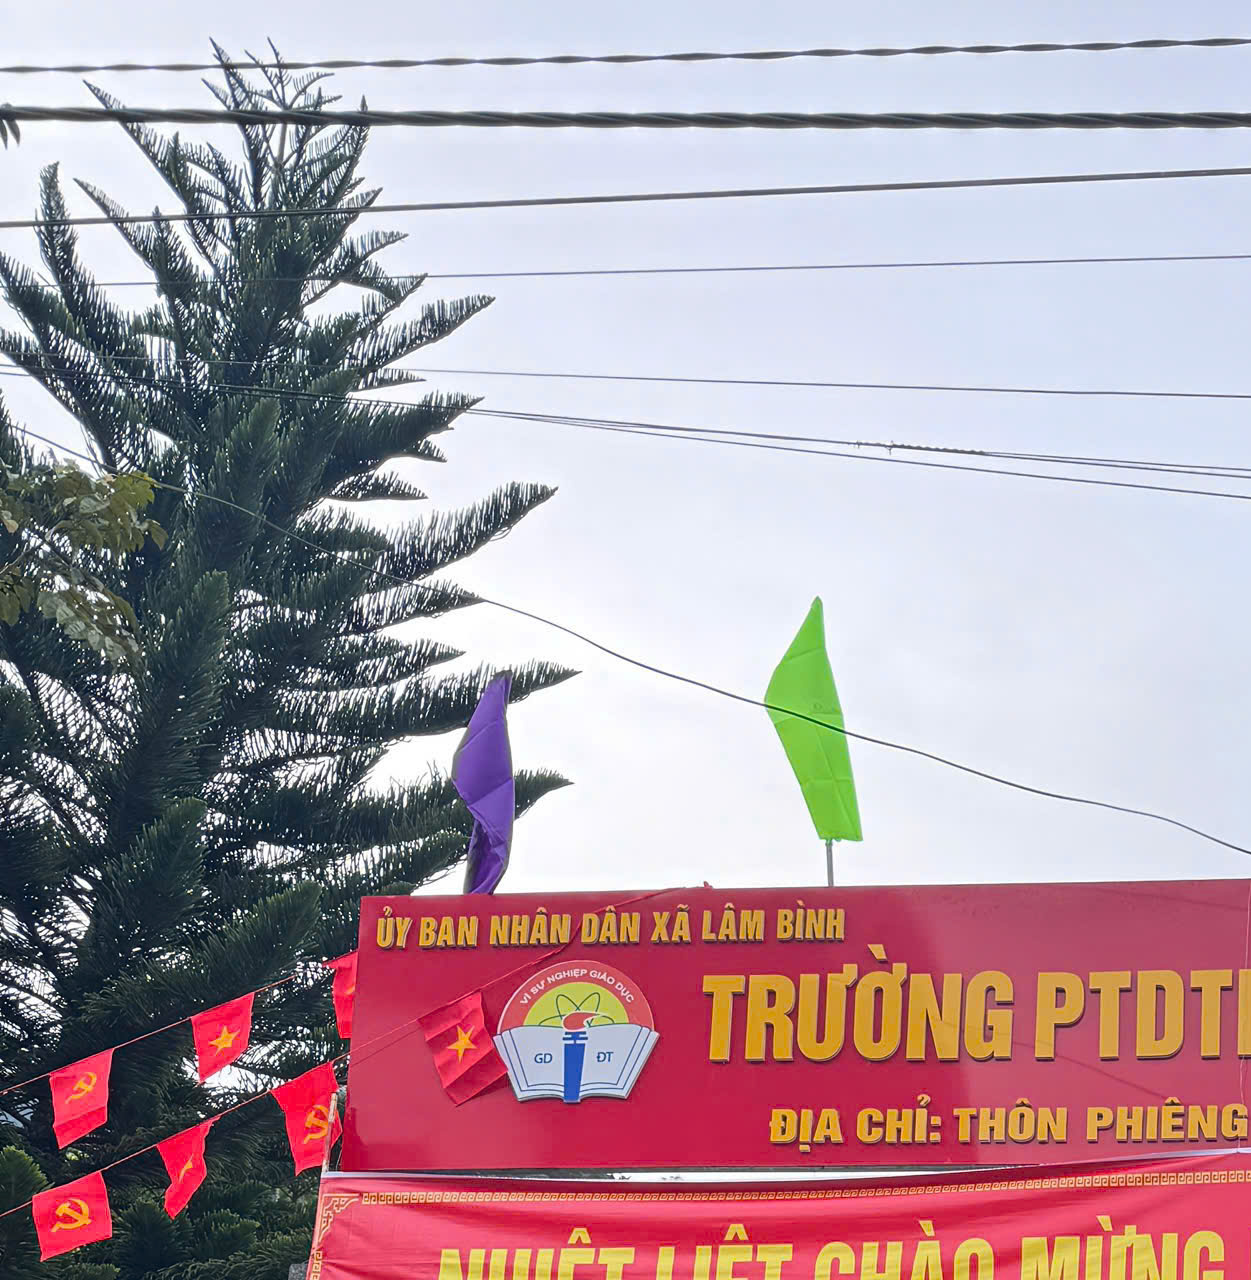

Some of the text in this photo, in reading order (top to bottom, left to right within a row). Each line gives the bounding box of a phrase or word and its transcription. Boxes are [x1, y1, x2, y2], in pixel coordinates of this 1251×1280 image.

[377, 900, 843, 947] ỦY BAN NHÂN DÂN XÃ LÂM BÌNH
[531, 980, 545, 994] SỰ
[547, 968, 588, 984] NGHIỆP
[615, 981, 634, 1003] DỤC
[704, 944, 1013, 1061] TRƯỜNG
[534, 1052, 613, 1064] GD ĐT
[770, 1110, 841, 1152] ĐỊA
[857, 1094, 939, 1143] CHỈ:
[954, 1098, 1066, 1141] THÔN
[1088, 1097, 1246, 1140] PHIÊNG
